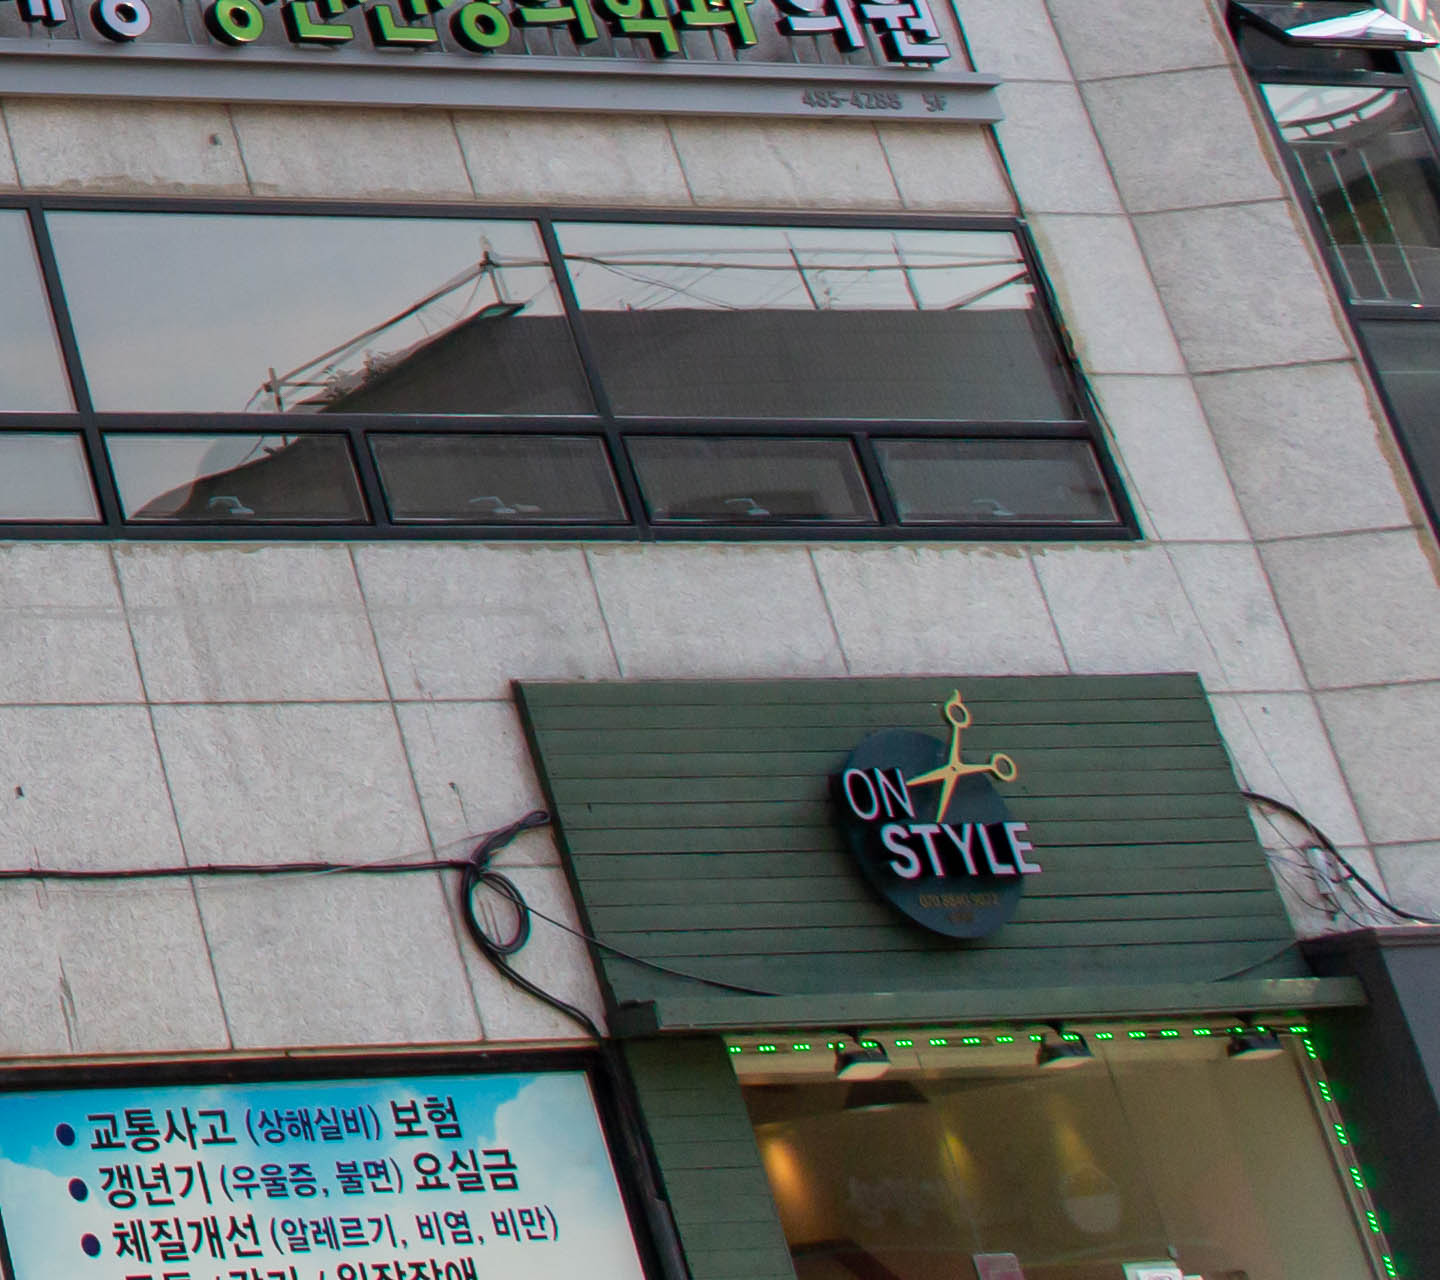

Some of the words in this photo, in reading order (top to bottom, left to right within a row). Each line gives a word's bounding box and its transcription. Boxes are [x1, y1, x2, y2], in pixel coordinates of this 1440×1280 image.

[842, 766, 917, 821] ON
[880, 821, 1043, 880] STYLE
[87, 1106, 238, 1153] 교통사고
[245, 1103, 381, 1147] (상해실비)
[389, 1095, 464, 1140] 보험
[97, 1158, 215, 1208] 갱년기
[219, 1161, 330, 1203] (우울증,
[334, 1156, 405, 1196] 불면)
[412, 1148, 521, 1193] 요실금
[111, 1212, 265, 1265] 체질개선
[269, 1212, 409, 1256] (알레르기,
[414, 1209, 486, 1247] 비염,
[489, 1203, 560, 1243] 비만)
